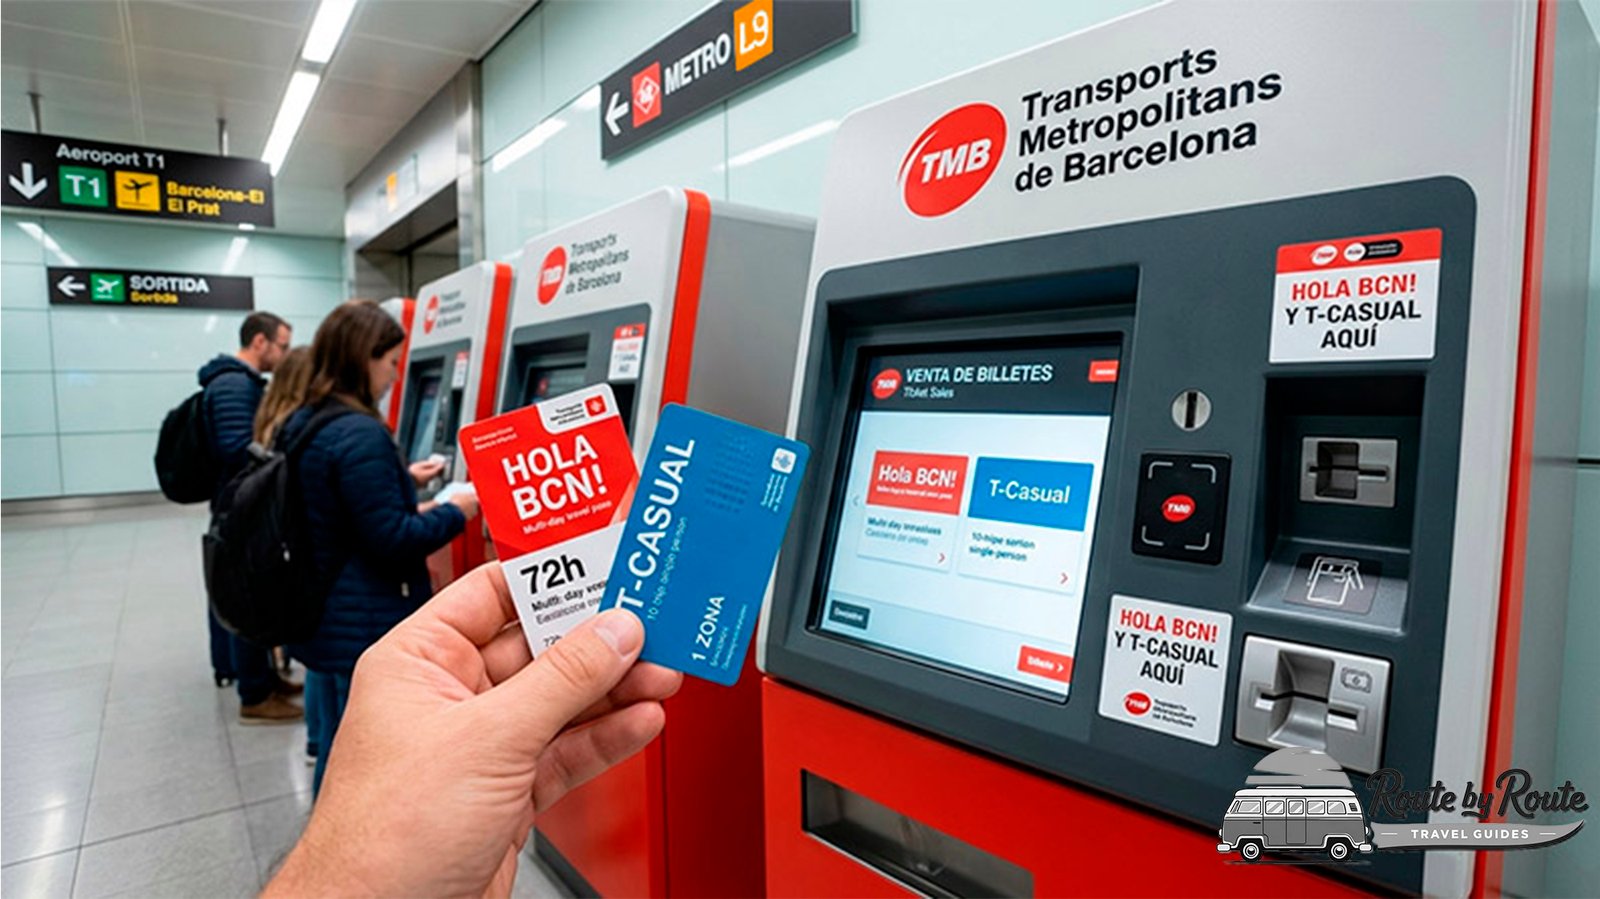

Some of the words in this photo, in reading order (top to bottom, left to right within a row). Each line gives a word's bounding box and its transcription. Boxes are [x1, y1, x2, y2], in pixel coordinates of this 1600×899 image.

[664, 32, 731, 96] METRO
[740, 10, 769, 55] L9
[1021, 48, 1218, 121] Transports
[1018, 72, 1283, 157] Metropolitans
[56, 143, 140, 167] Aeroport
[143, 152, 165, 169] T1
[920, 138, 992, 184] TMB
[1015, 163, 1053, 192] de
[1062, 121, 1257, 183] Barcelona
[65, 174, 100, 199] T1
[130, 274, 210, 293] SORTIDA
[1292, 279, 1350, 302] HOLA
[1358, 273, 1417, 297] BCN!
[1285, 307, 1299, 326] Y
[1305, 300, 1422, 324] T-CASUAL
[1321, 323, 1379, 350] AQUÍ
[906, 367, 950, 383] VENTA
[953, 366, 974, 382] DE
[977, 364, 1054, 382] BILLETES
[501, 434, 598, 486] HOLA
[878, 464, 913, 484] Hola
[915, 467, 958, 489] BCN!
[511, 464, 608, 520] BCN!
[990, 478, 1071, 505] T-Casual
[614, 439, 696, 609] T-CASUAL
[520, 554, 586, 595] 72h
[543, 632, 563, 648] 72
[696, 596, 726, 649] ZONA
[1120, 609, 1167, 634] HOLA
[1172, 617, 1218, 644] BCN!
[691, 651, 706, 661] 1
[1115, 631, 1126, 648] Y
[1130, 633, 1220, 669] T-CASUAL
